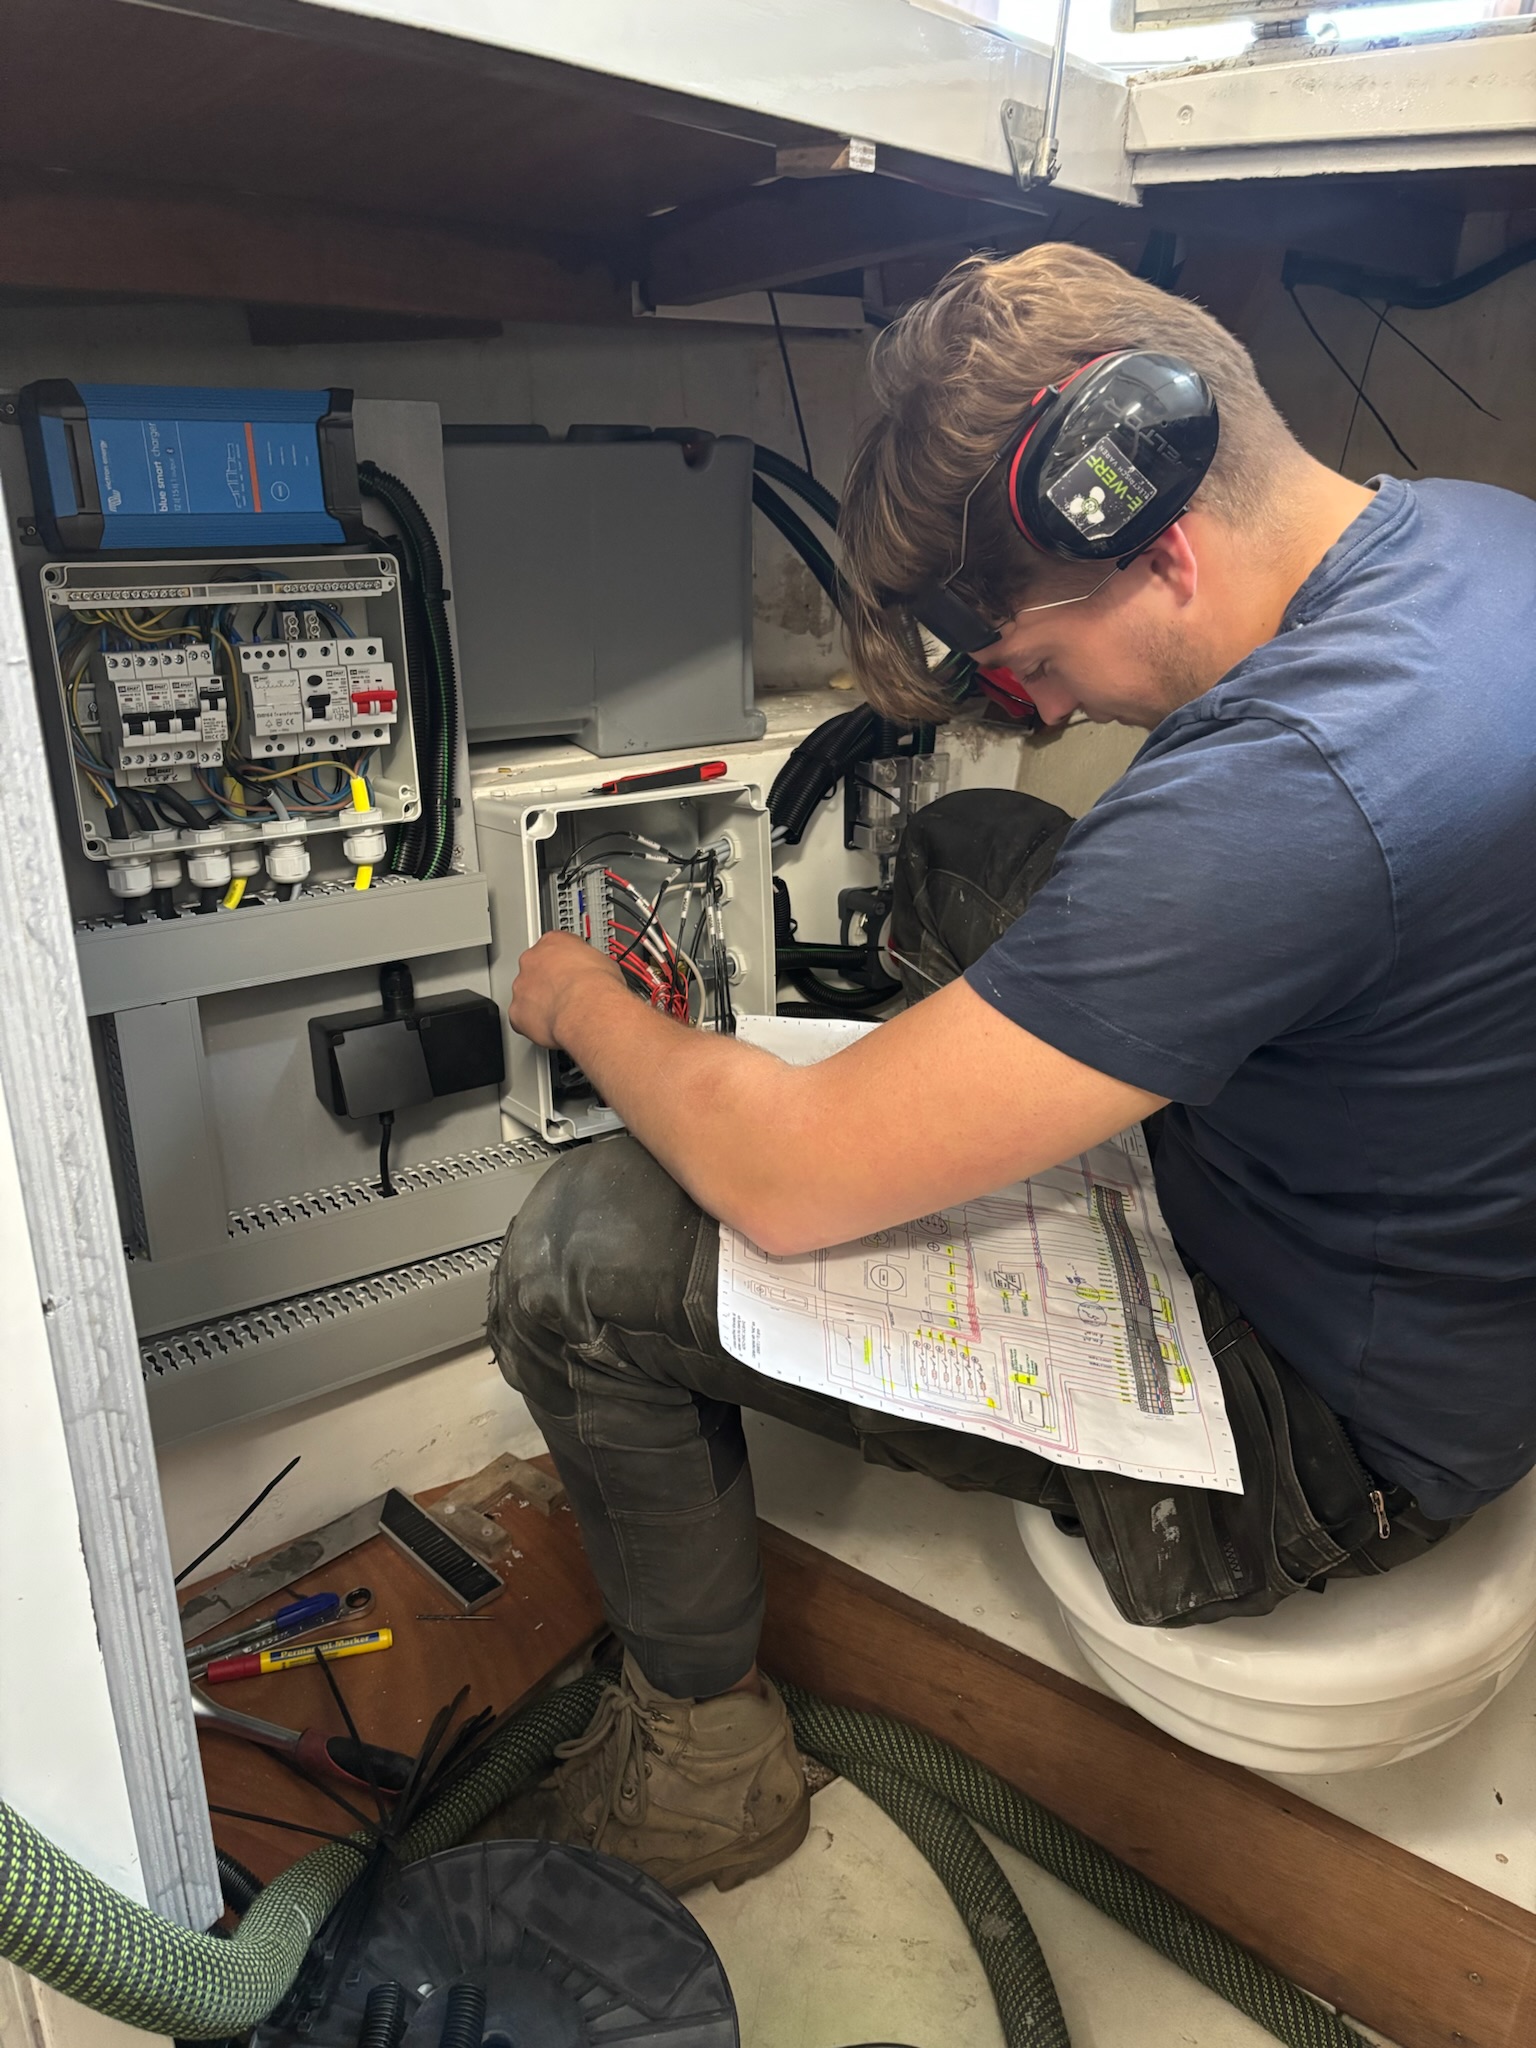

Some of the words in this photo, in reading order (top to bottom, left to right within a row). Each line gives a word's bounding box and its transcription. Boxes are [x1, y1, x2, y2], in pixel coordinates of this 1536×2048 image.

[99, 439, 109, 464] energy
[148, 422, 161, 457] charger
[1098, 444, 1119, 468] VAREN
[102, 465, 113, 490] victron
[153, 461, 165, 489] smart
[1085, 455, 1144, 512] E-WERF
[1116, 464, 1150, 500] ELEKTRISCH
[158, 491, 168, 512] blue
[333, 1633, 371, 1649] Marker
